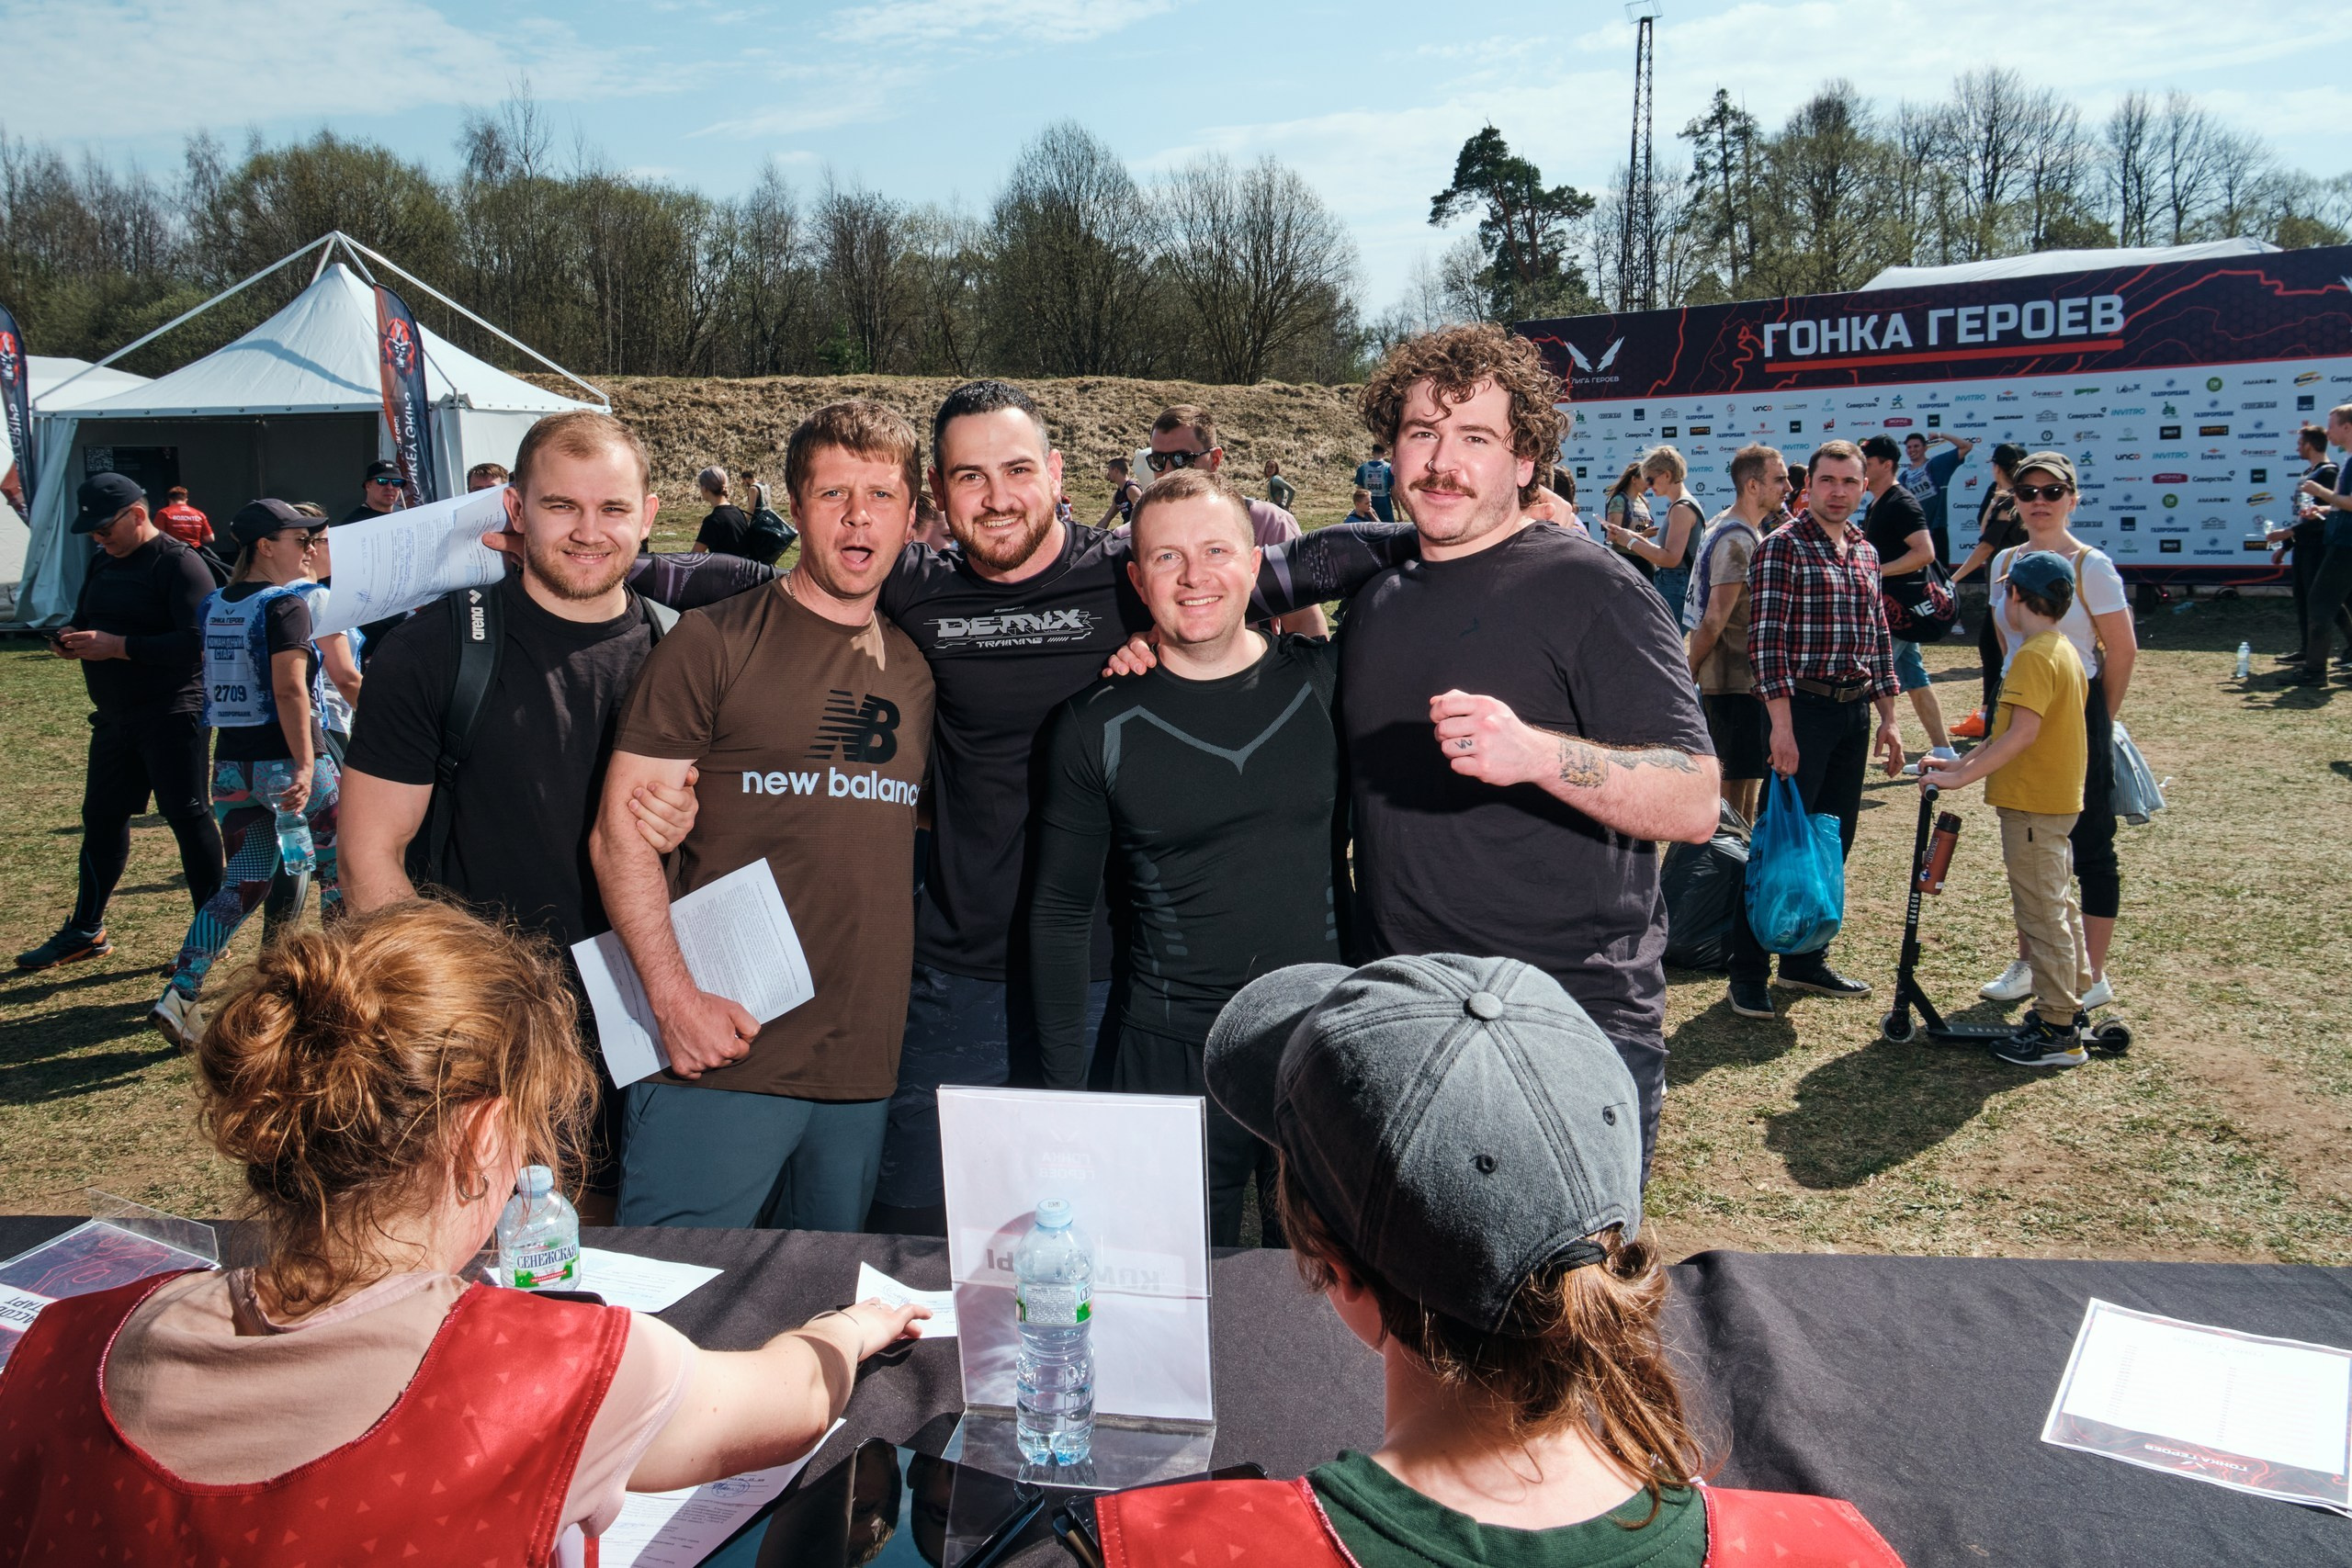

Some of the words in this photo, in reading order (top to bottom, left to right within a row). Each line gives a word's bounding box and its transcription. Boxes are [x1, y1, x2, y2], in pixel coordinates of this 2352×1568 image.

[1762, 313, 1914, 358] ГОНКА
[1928, 294, 2125, 346] ГЕРОЕВ
[470, 606, 485, 640] arena
[976, 637, 1043, 649] TRAINING
[214, 684, 247, 702] 2709
[742, 771, 820, 795] new
[828, 767, 920, 807] balanc
[517, 1243, 577, 1269] СЕНЕЖСКАЯ
[4, 1296, 44, 1314] ТАРТ
[2144, 1444, 2199, 1460] ГЕРОЕВ
[2200, 1456, 2248, 1472] ГОНКА
